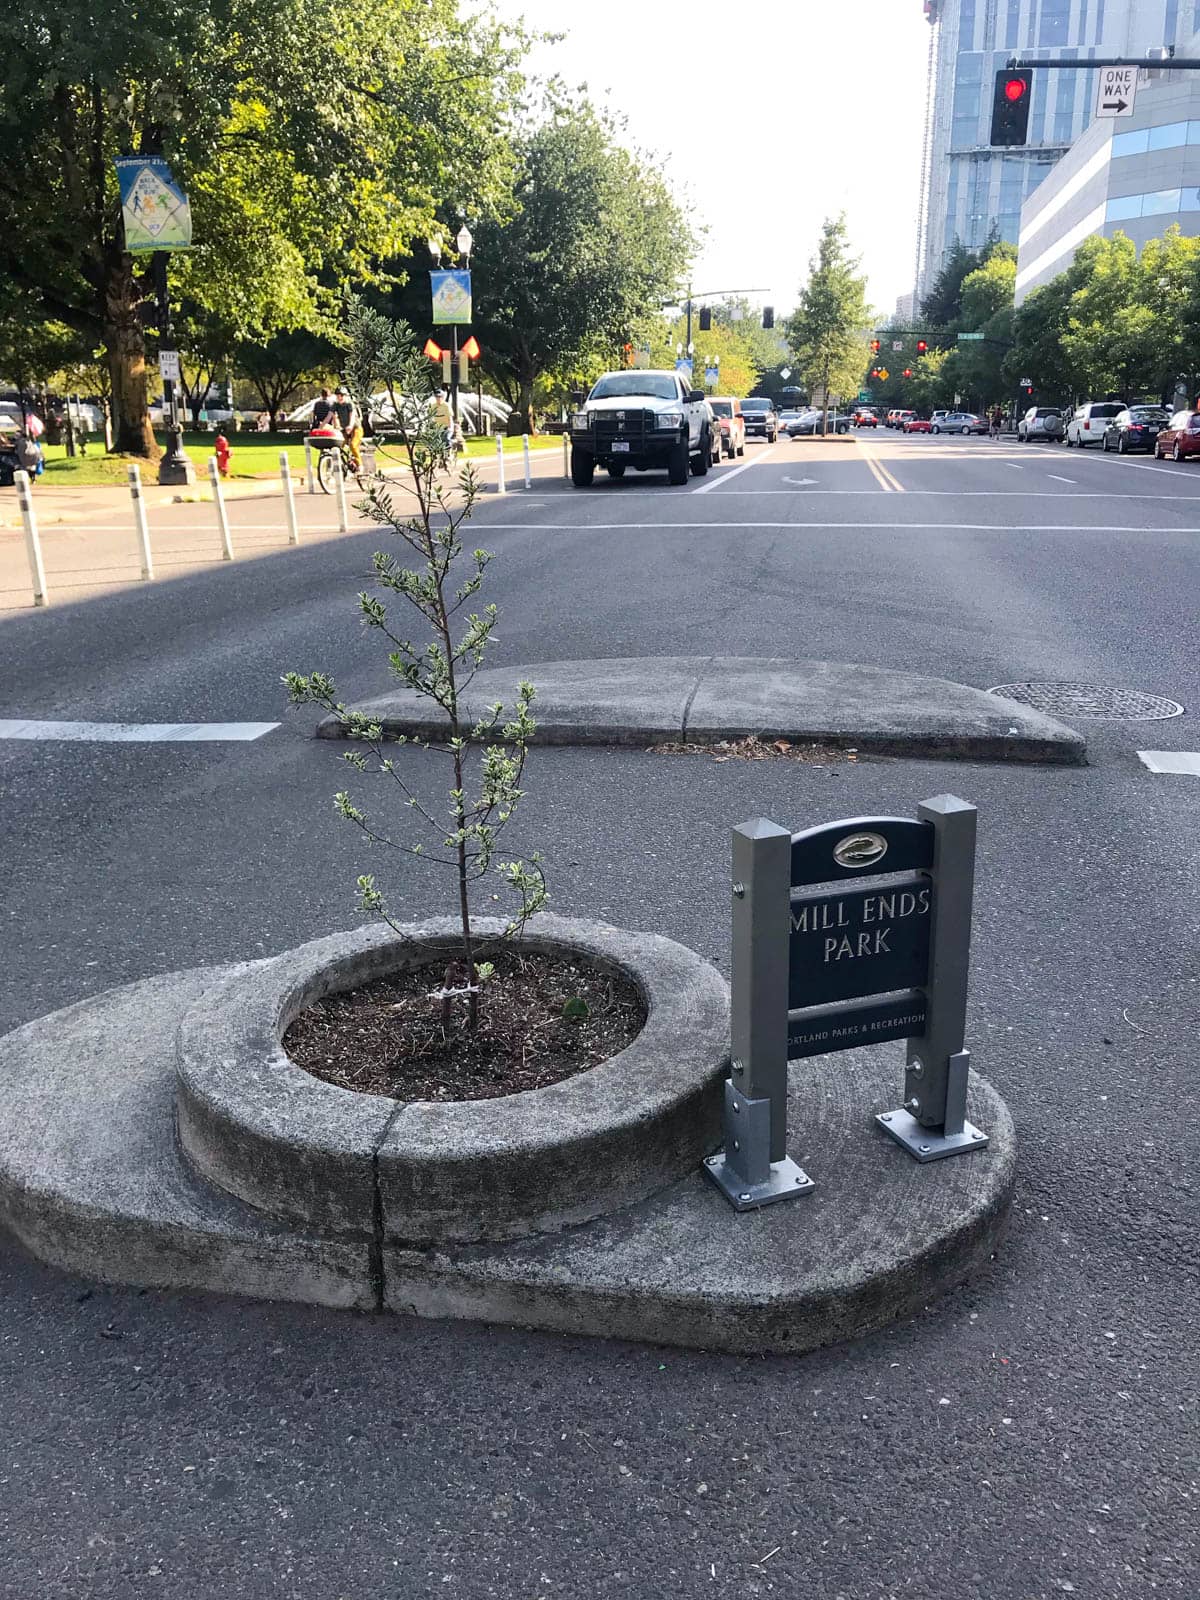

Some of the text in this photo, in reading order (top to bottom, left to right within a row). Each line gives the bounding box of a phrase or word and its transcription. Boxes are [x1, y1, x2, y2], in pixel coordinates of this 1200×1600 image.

[1106, 70, 1132, 82] ONE
[1104, 84, 1131, 96] WAY
[115, 159, 150, 167] September
[789, 889, 930, 934] MILL ENDS
[823, 927, 892, 962] PARK
[787, 1013, 925, 1047] ORTLAND PARKS & RECREATION
